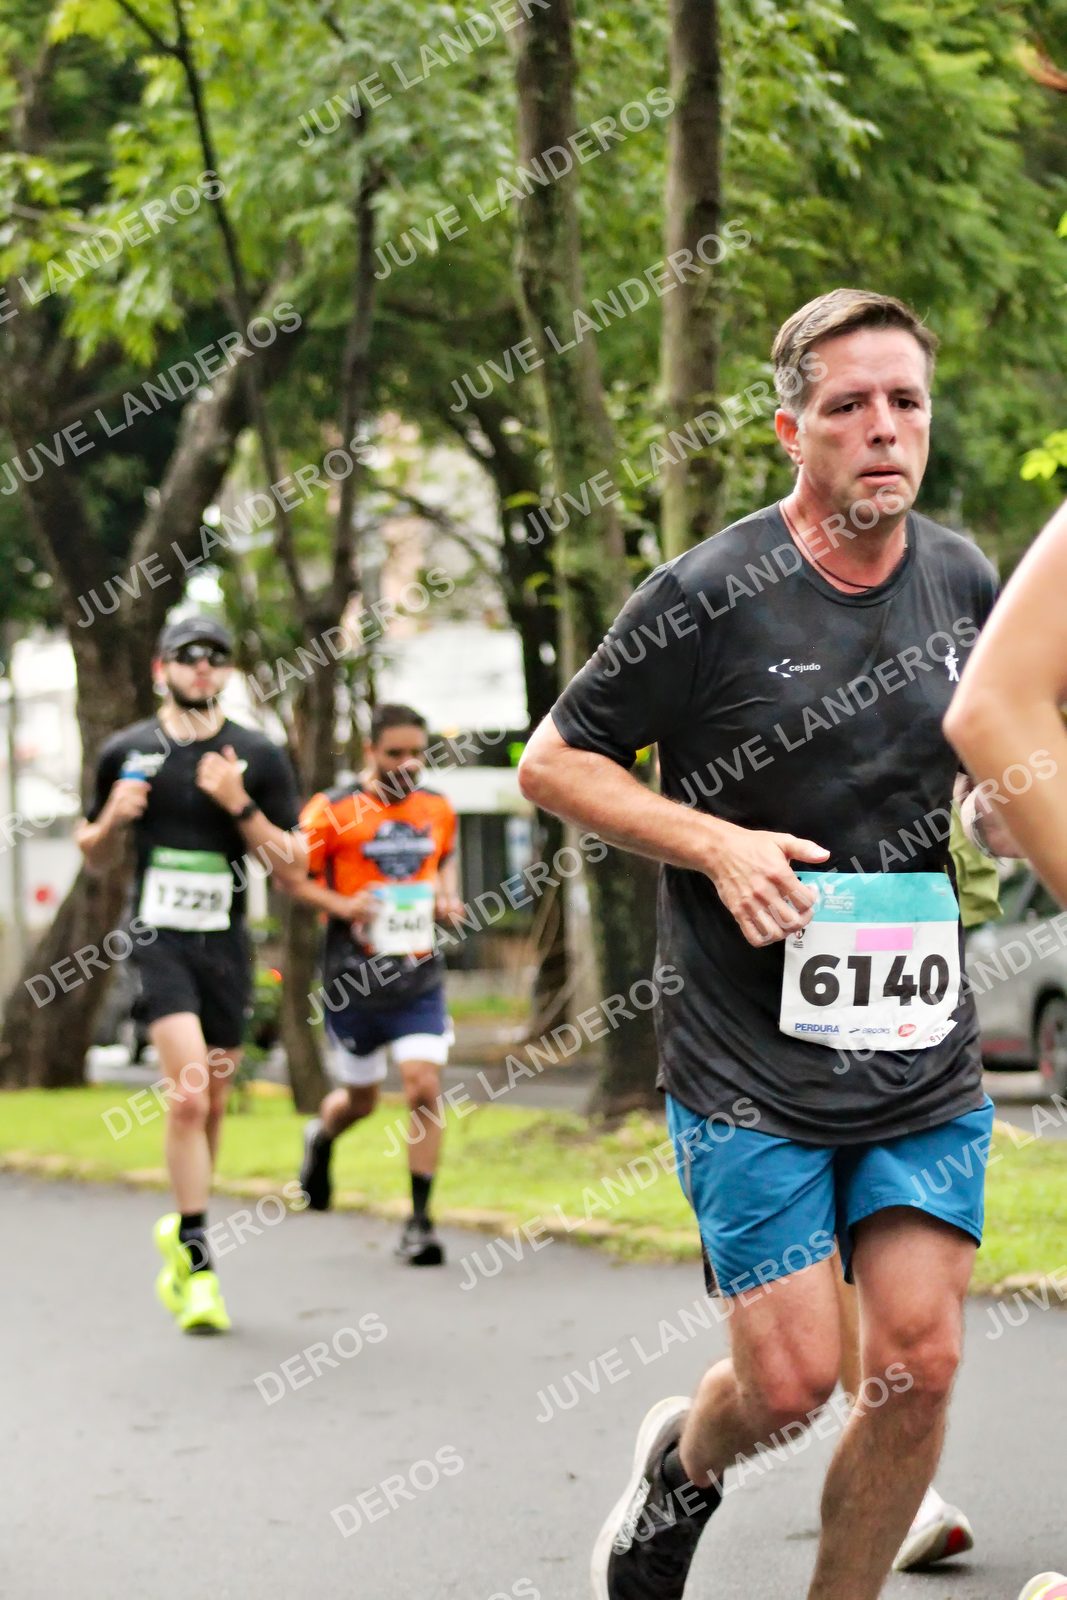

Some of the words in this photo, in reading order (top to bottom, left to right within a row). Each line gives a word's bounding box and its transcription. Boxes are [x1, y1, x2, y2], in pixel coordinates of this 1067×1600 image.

[789, 663, 821, 673] cejudo
[800, 953, 949, 1007] 6140
[795, 1023, 840, 1033] PERDURA
